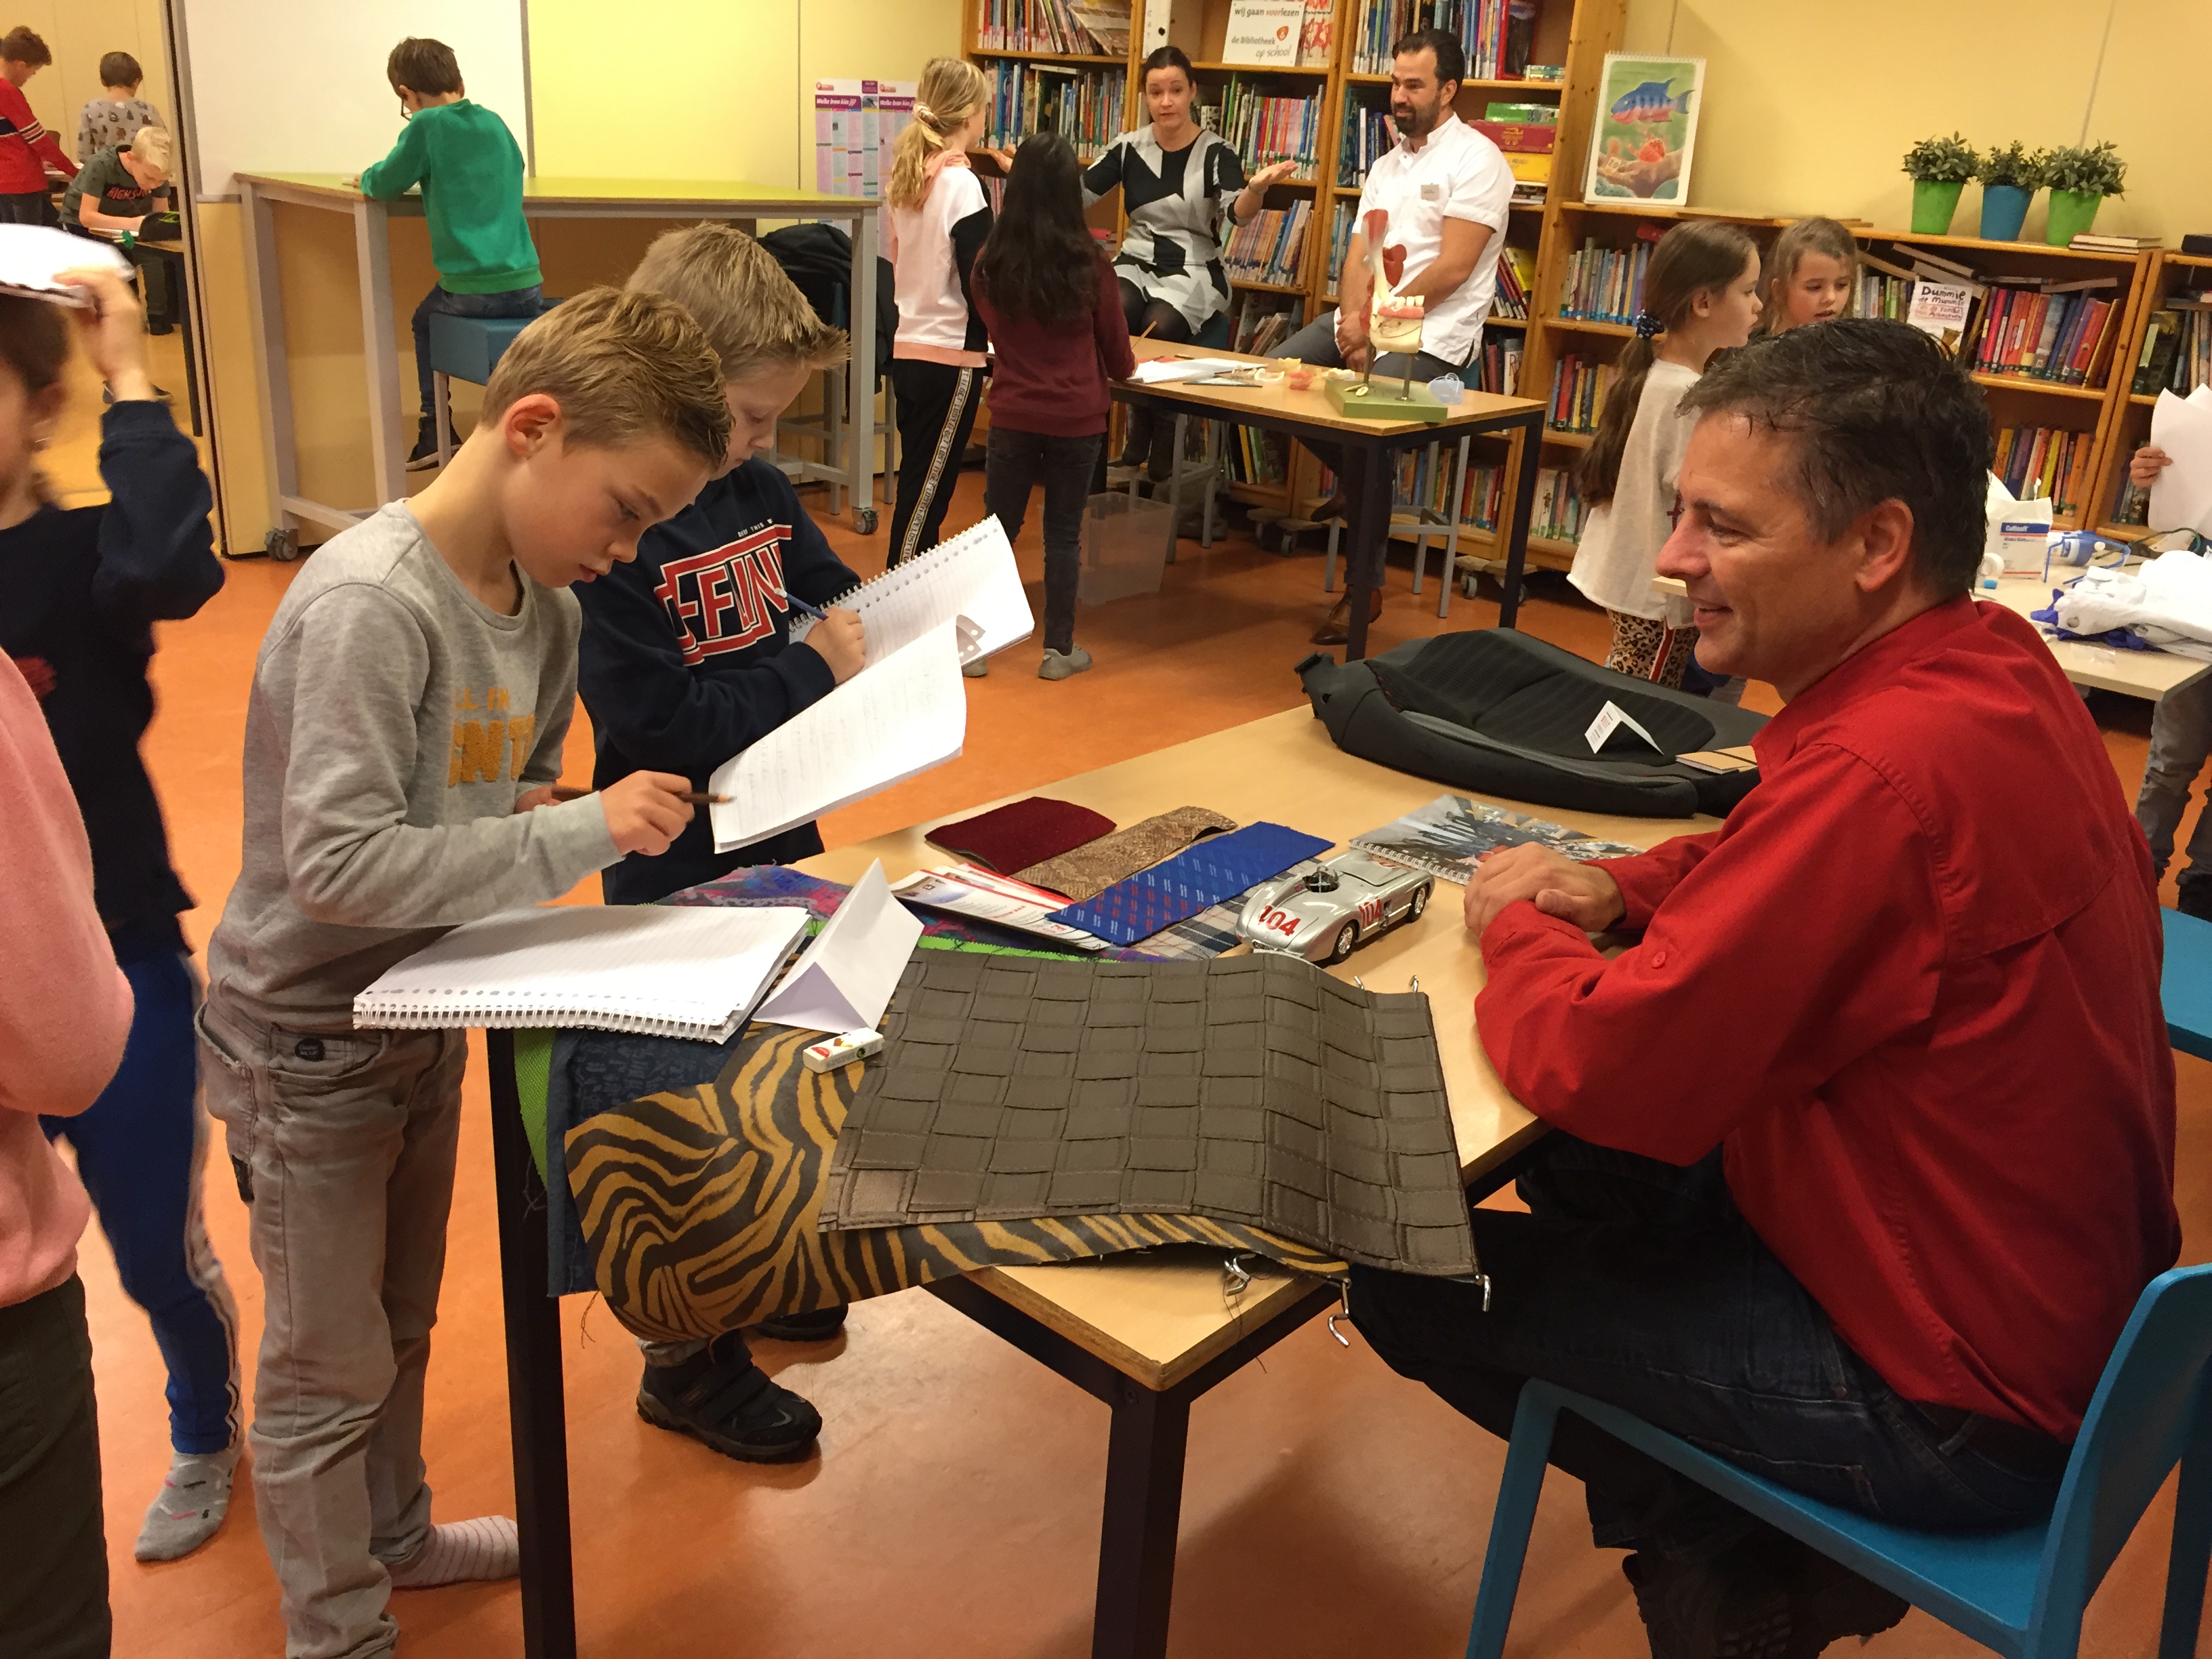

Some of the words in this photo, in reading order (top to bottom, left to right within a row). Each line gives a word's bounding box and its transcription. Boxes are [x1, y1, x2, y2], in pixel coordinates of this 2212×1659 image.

[1235, 7, 1245, 17] wij
[1247, 8, 1265, 18] gaan
[1266, 8, 1300, 16] voorlezen
[1241, 37, 1275, 45] Bibliotheek
[1256, 50, 1265, 61] op
[1267, 45, 1292, 57] school
[1921, 286, 1966, 300] Dummie
[1357, 897, 1382, 928] 104
[1258, 905, 1301, 937] 104
